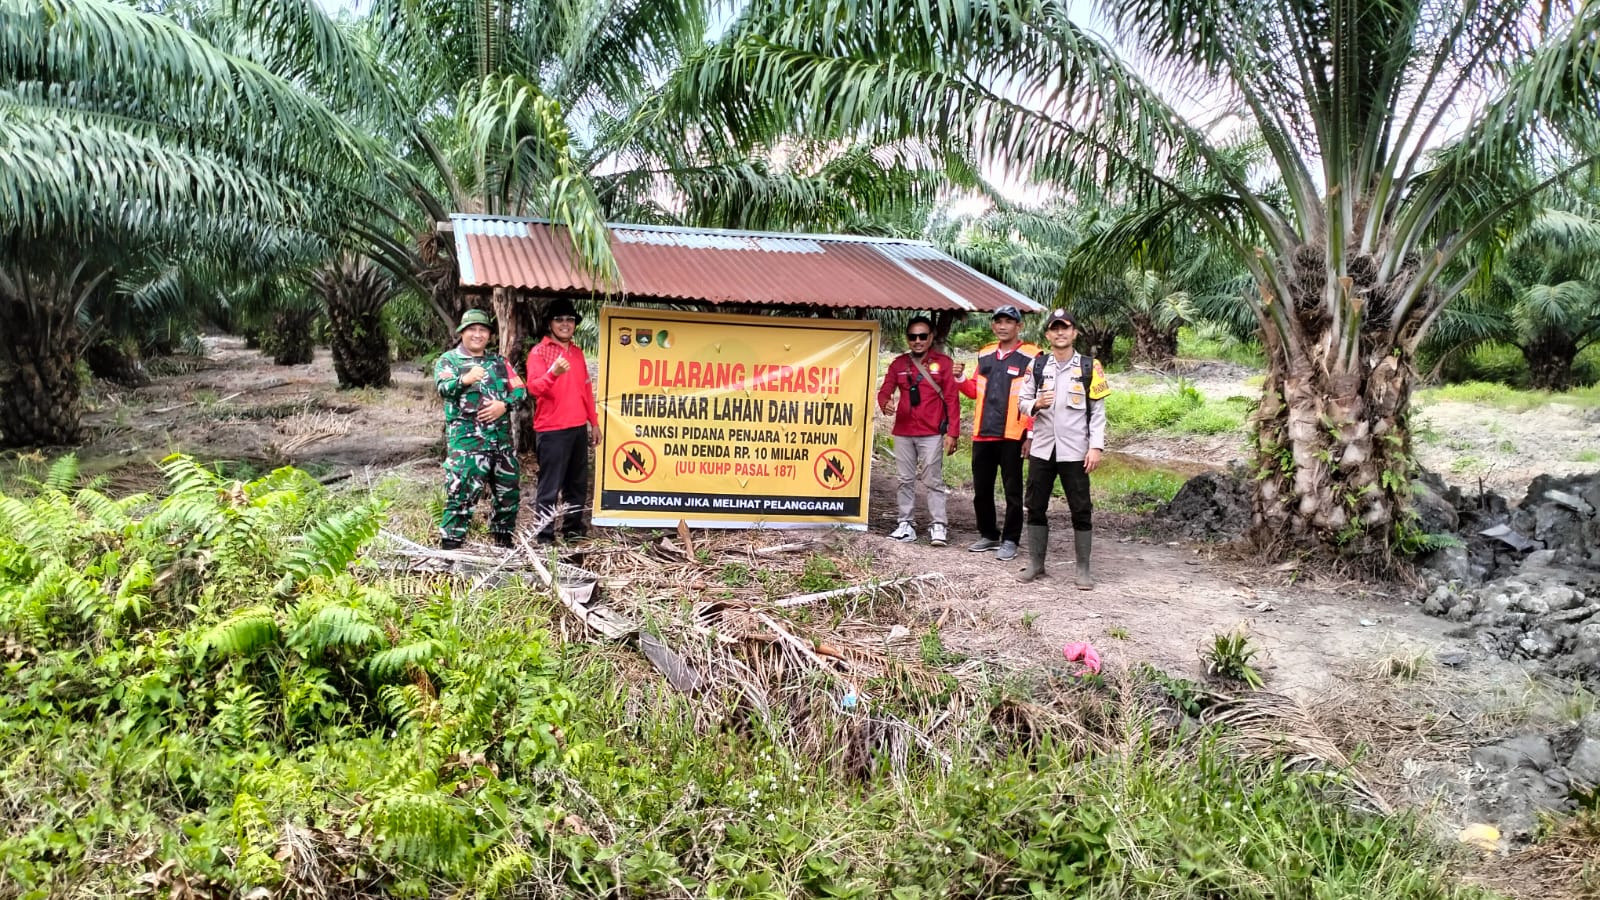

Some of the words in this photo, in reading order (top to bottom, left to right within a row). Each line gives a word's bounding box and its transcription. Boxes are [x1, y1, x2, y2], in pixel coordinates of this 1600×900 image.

[638, 358, 745, 391] DILARANG
[753, 364, 840, 394] KERAS!!!
[620, 393, 708, 420] MEMBAKAR
[713, 397, 763, 422] LAHAN
[768, 400, 799, 424] DAN
[803, 401, 853, 426] HUTAN
[635, 424, 678, 439] SANKSI
[682, 427, 725, 441] PIDANA
[728, 428, 780, 443] PENJARA
[784, 431, 797, 444] 12
[800, 432, 838, 445] TAHUN
[664, 443, 688, 456] DAN
[691, 444, 730, 458] DENDA
[734, 446, 751, 459] RP.
[755, 447, 768, 460] 10
[771, 448, 809, 461] MILIAR
[675, 460, 696, 477] (UU
[699, 461, 732, 475] KUHP
[734, 463, 770, 477] PASAL
[774, 465, 797, 480] 187)
[619, 495, 682, 506] LAPORKAN
[684, 498, 710, 507] JIKA
[712, 499, 761, 509] MELIHAT
[763, 500, 844, 510] PELANGGARAN
